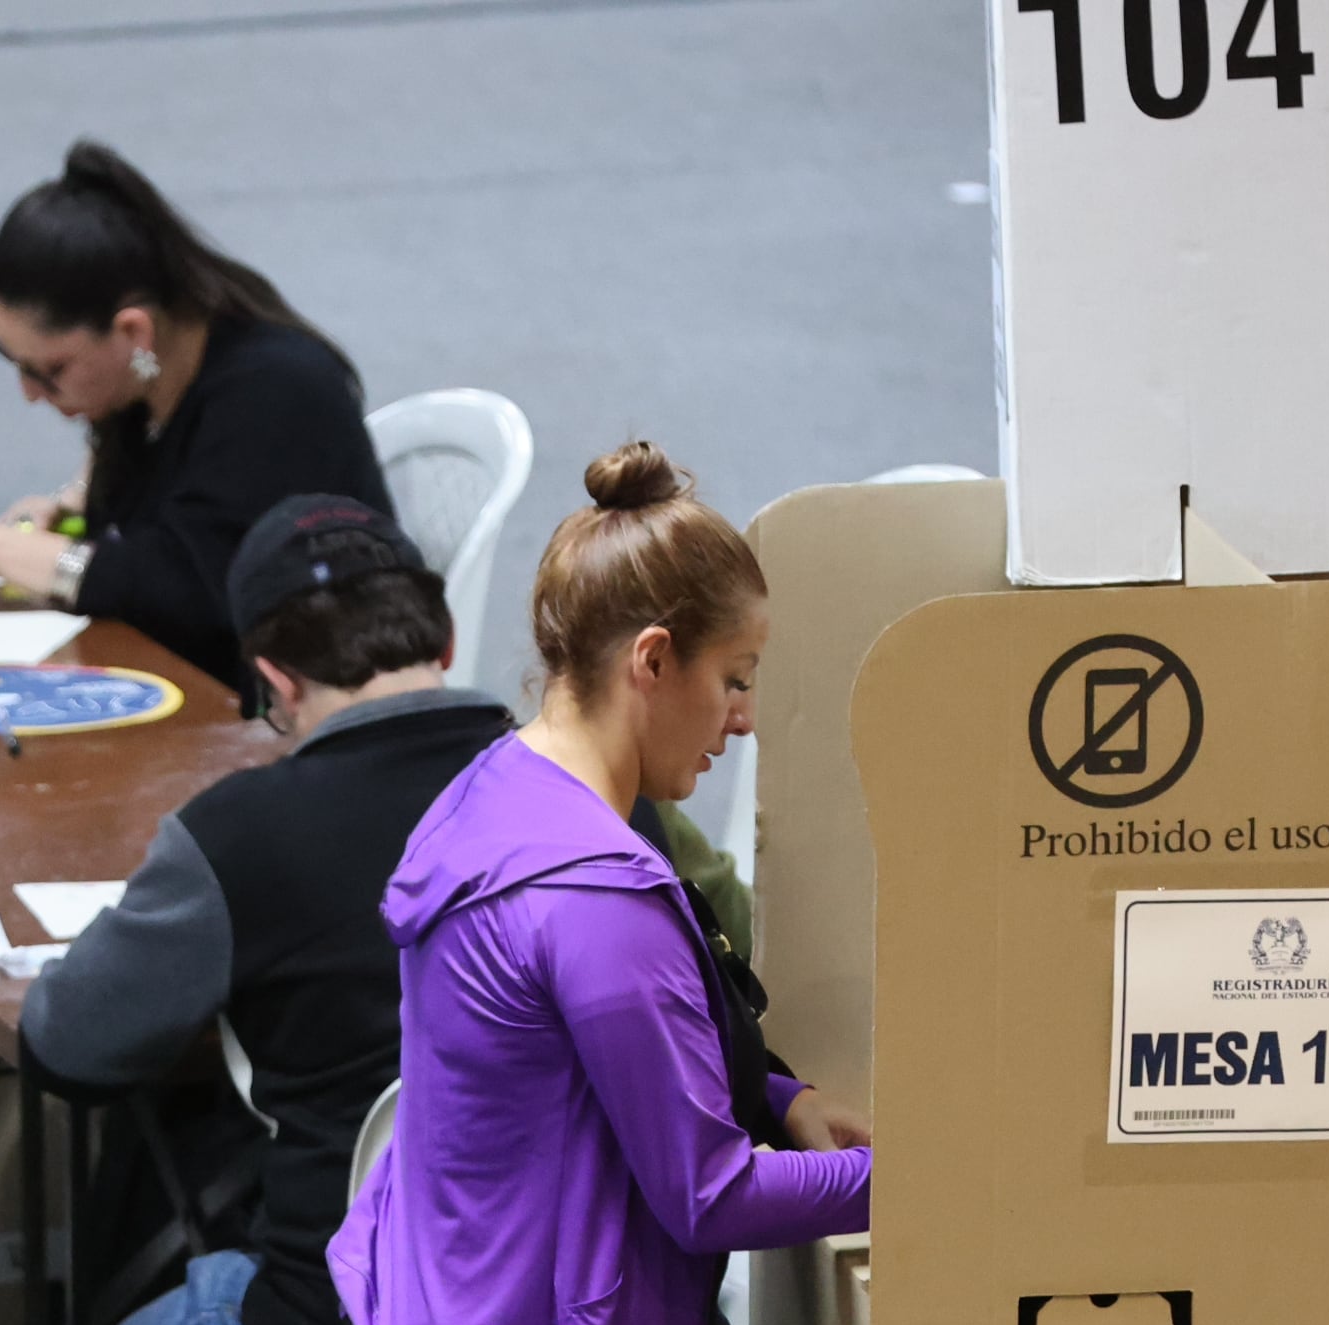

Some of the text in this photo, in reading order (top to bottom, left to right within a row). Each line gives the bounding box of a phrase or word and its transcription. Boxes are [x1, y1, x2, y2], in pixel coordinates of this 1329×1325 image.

[1017, 0, 1315, 124] 104
[1020, 819, 1211, 858] Prohibido
[1225, 817, 1257, 851] el
[1128, 1030, 1286, 1088] MESA
